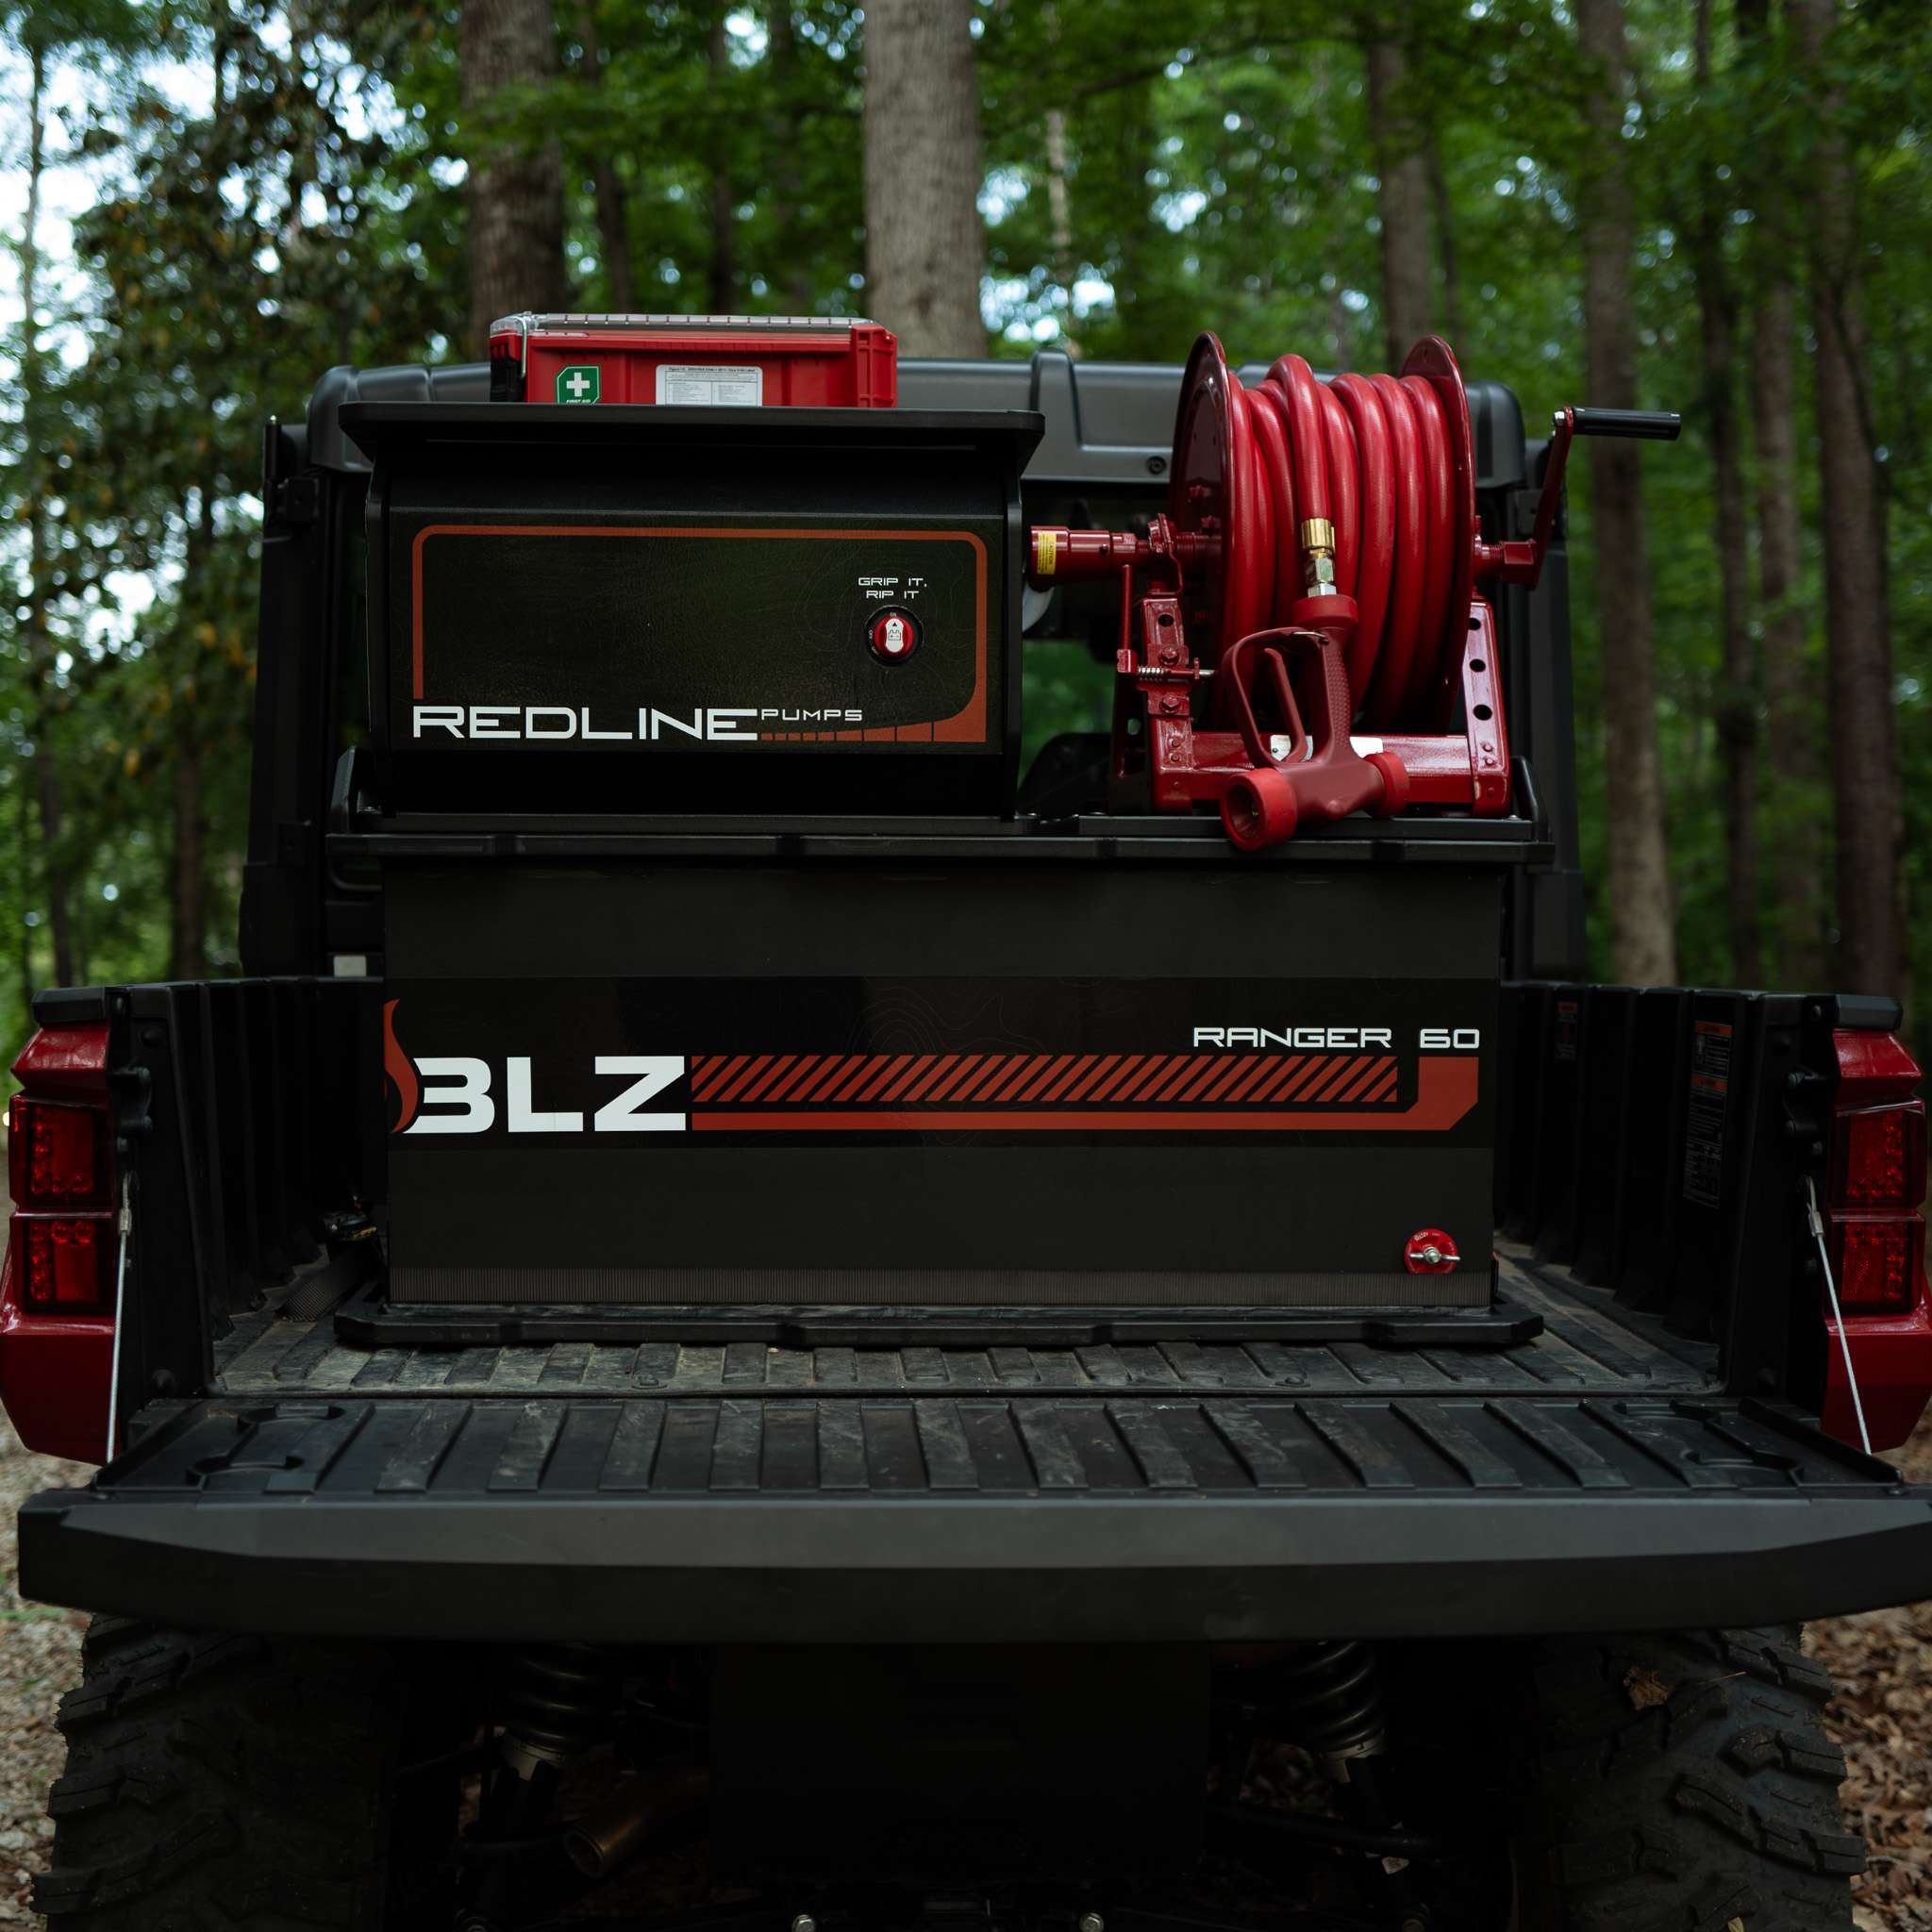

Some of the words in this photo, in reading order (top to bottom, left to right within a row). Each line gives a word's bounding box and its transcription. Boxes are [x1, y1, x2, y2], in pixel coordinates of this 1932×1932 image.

[858, 576, 899, 587] GRIP
[865, 590, 894, 599] RIP
[903, 590, 921, 600] IT
[412, 706, 758, 741] REDLINE
[760, 708, 863, 722] PUMPS
[1193, 1026, 1392, 1049] RANGER
[1419, 1028, 1480, 1049] 60
[403, 1056, 687, 1134] BLZ
